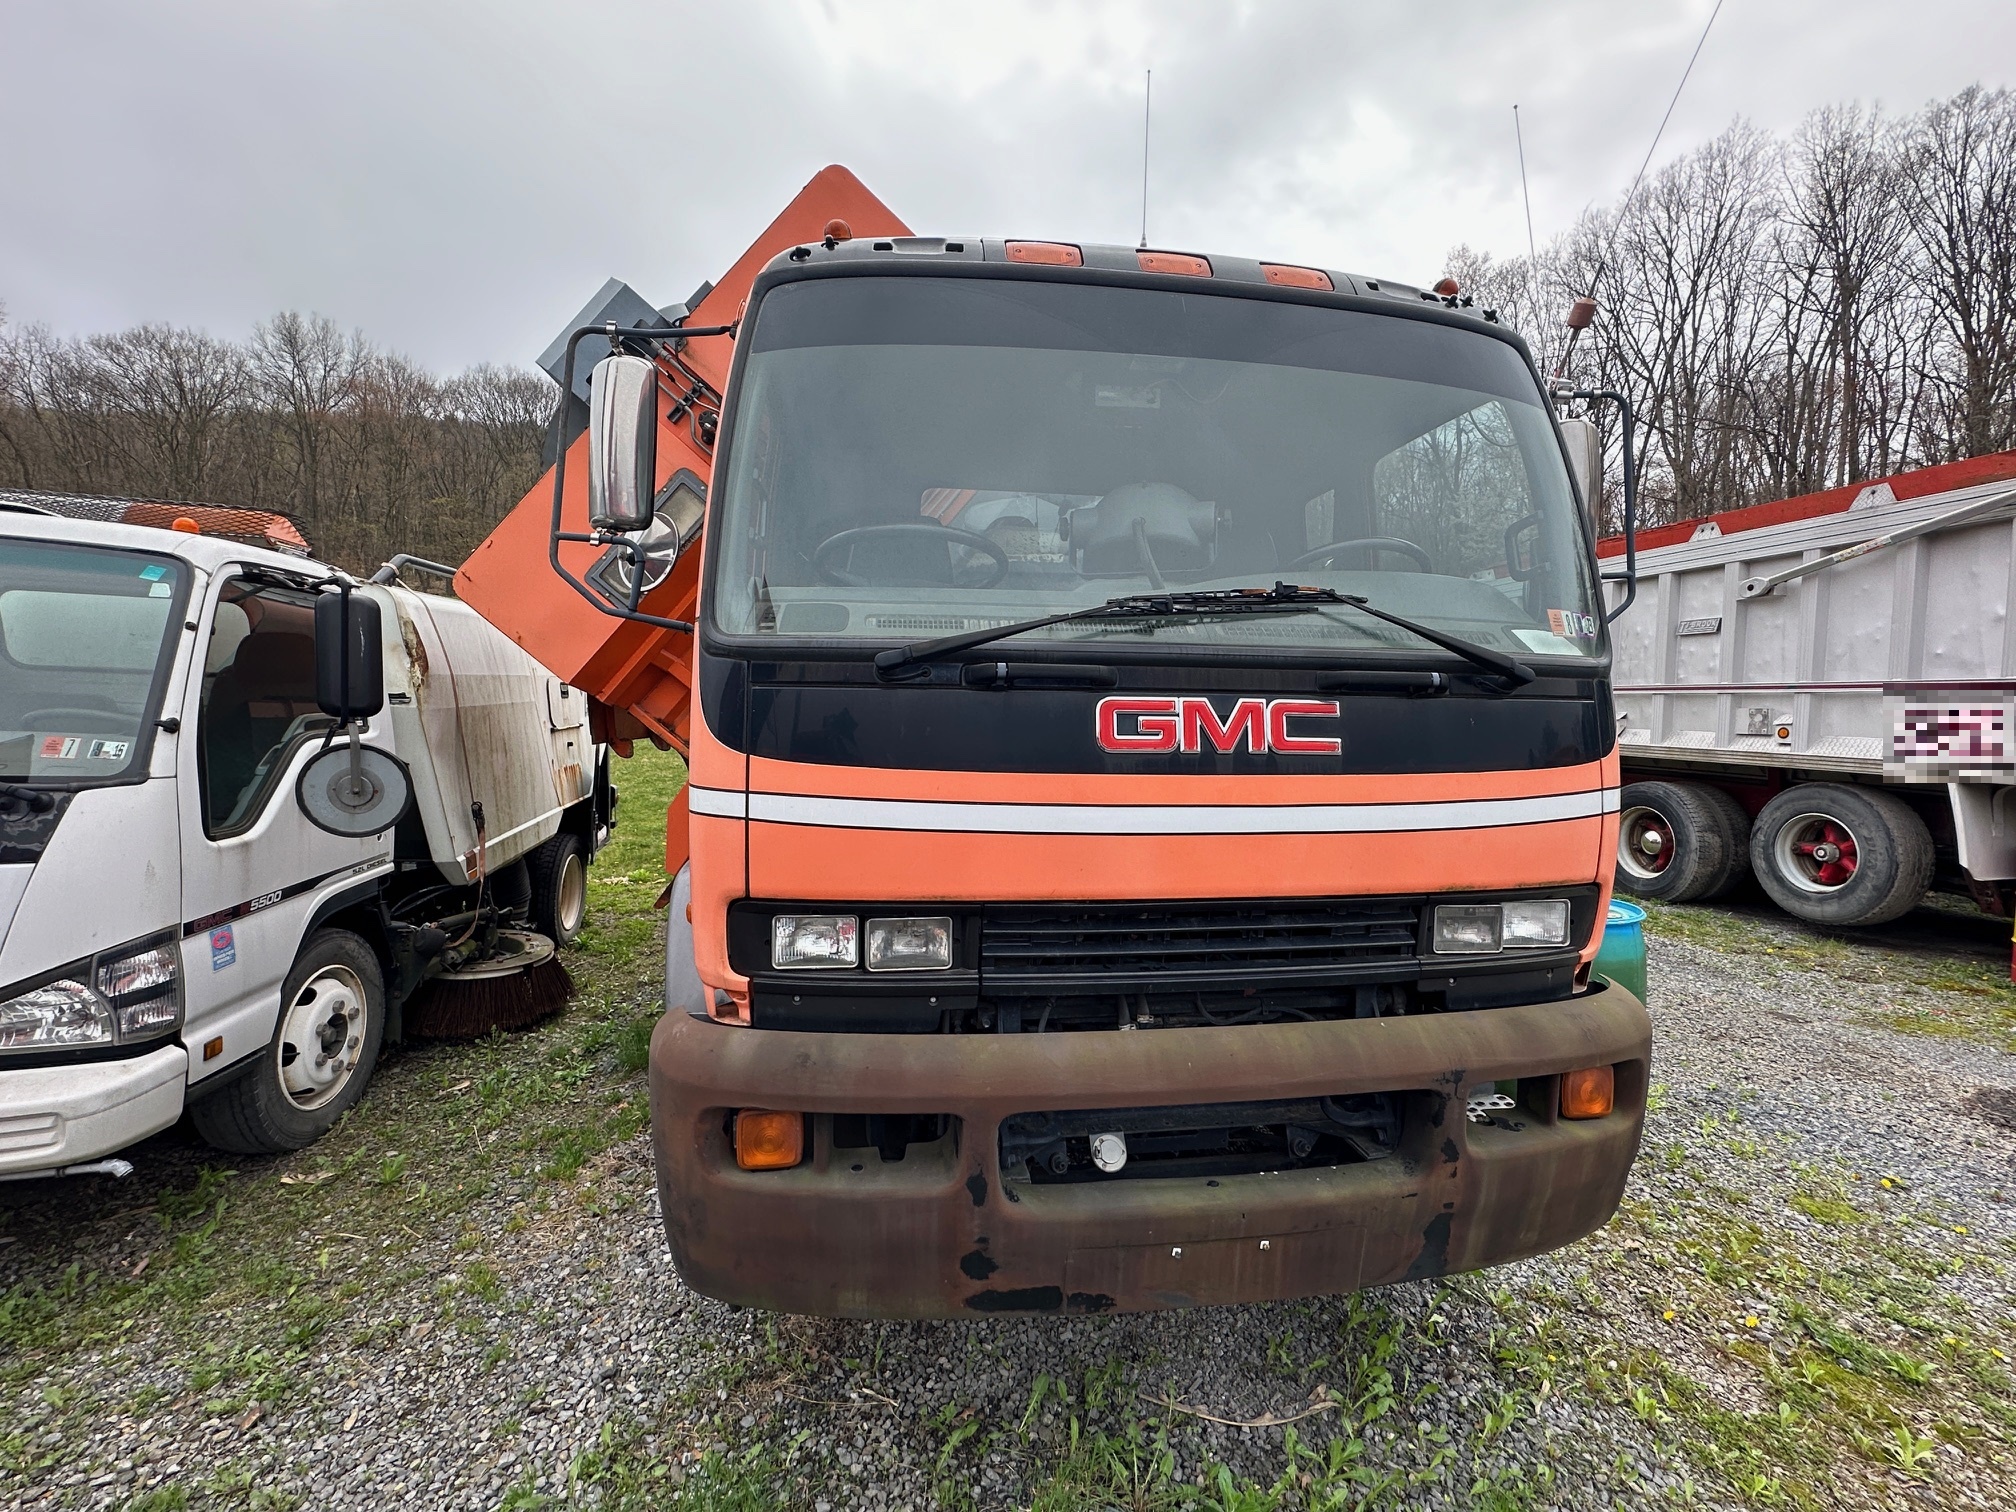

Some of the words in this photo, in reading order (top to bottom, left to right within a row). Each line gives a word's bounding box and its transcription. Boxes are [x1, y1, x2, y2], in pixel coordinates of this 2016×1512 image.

[1096, 696, 1342, 755] GMC
[193, 908, 233, 932] GMC
[250, 890, 283, 911] 5500
